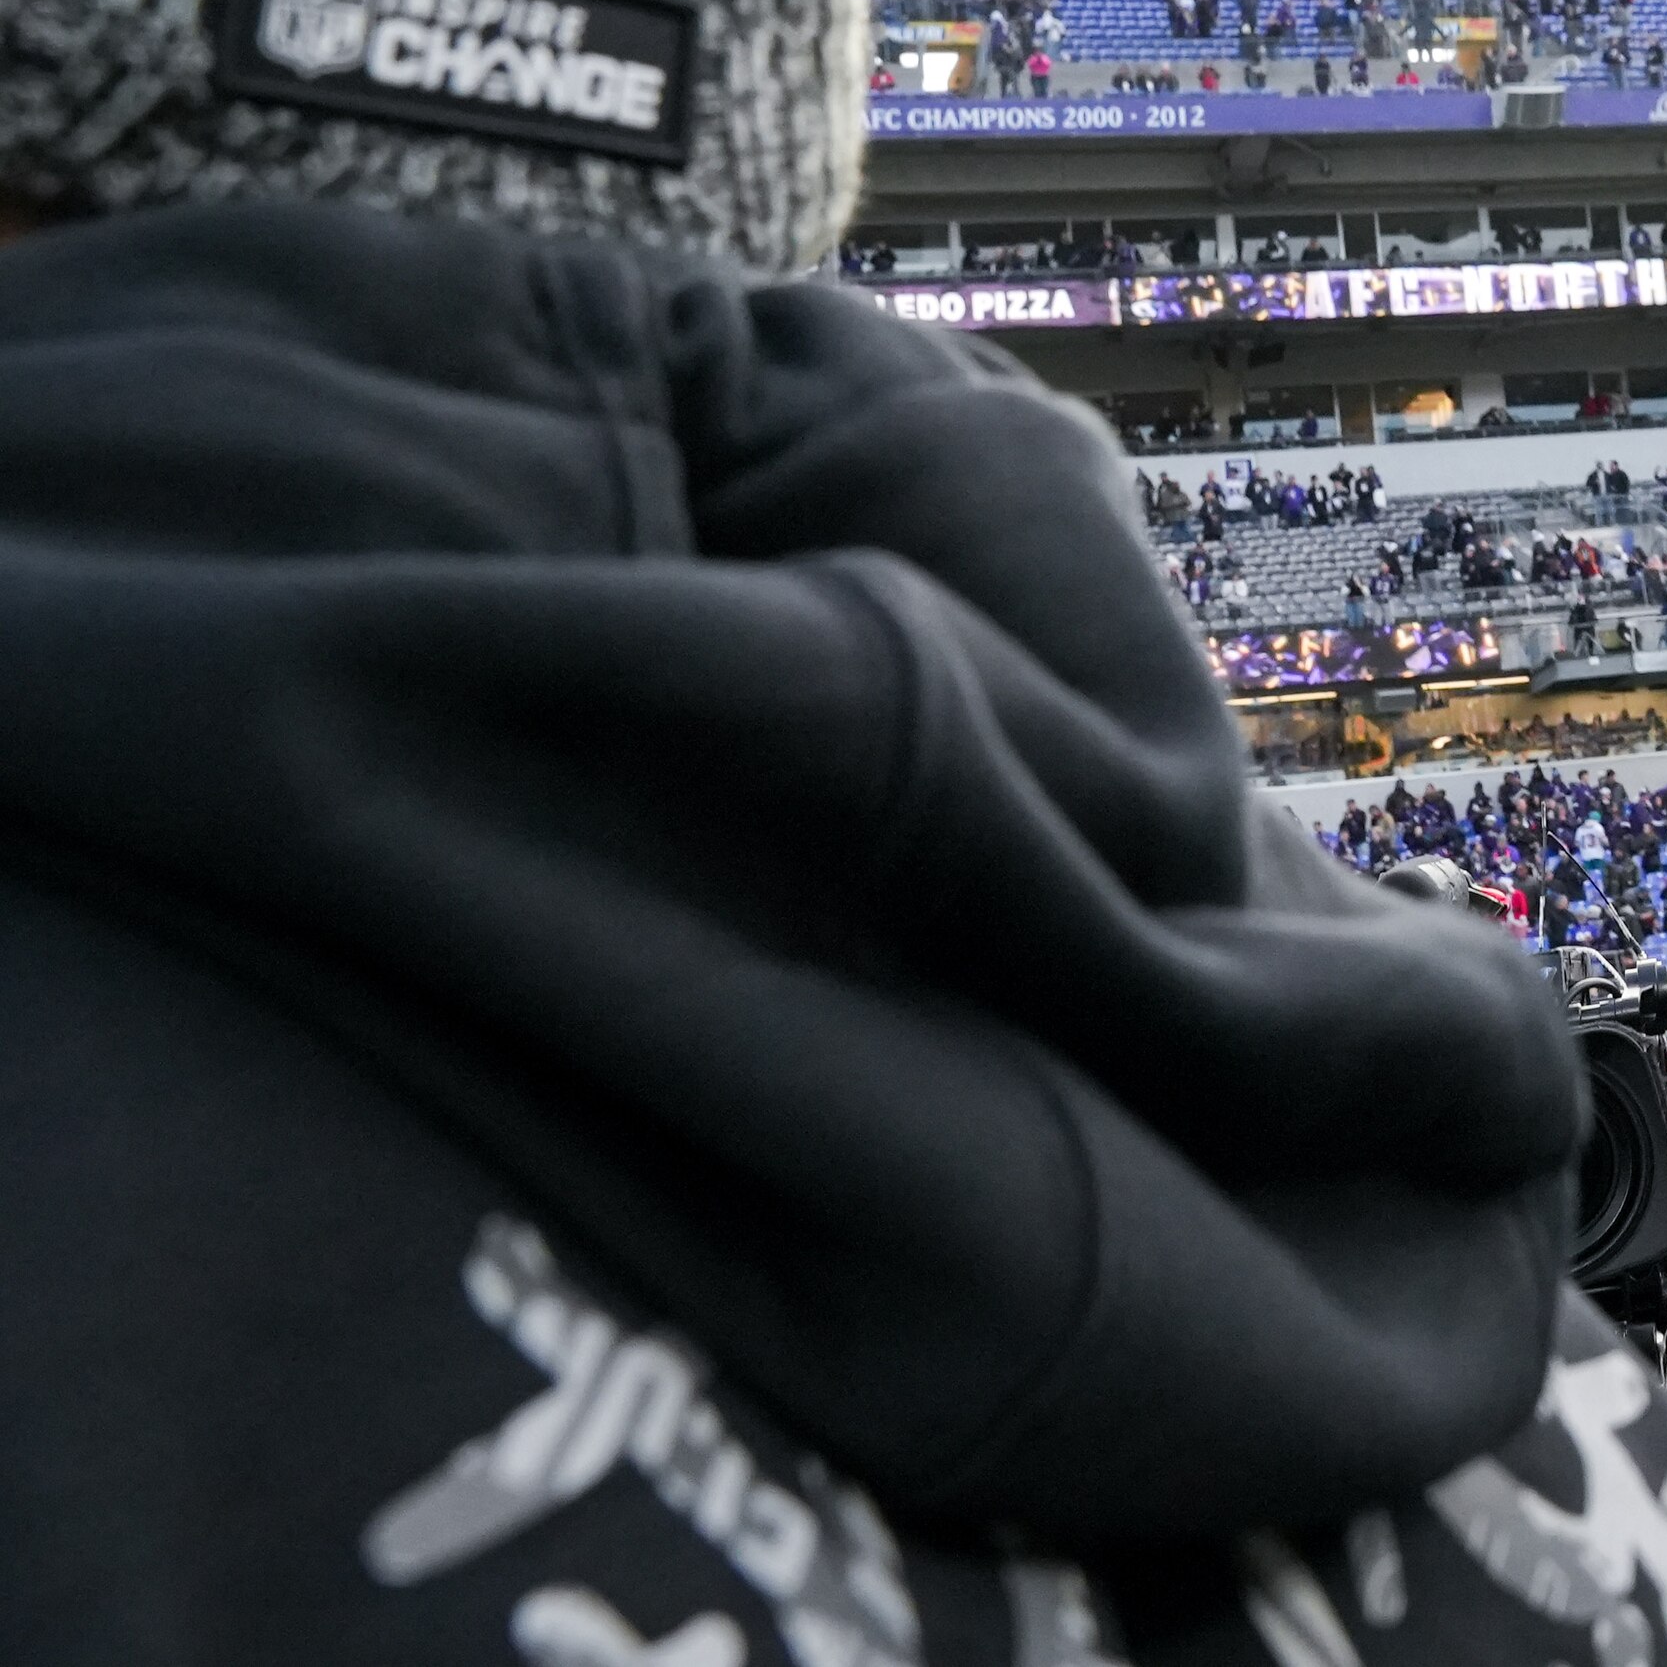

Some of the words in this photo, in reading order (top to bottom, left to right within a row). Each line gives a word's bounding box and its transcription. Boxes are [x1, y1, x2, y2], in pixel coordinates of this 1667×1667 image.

[365, 15, 667, 131] CHANGE
[906, 107, 1057, 132] CHAMPIONS
[1062, 106, 1123, 130] 2000
[1145, 104, 1206, 129] 2012
[971, 288, 1076, 322] PIZZA
[1304, 267, 1421, 320] AFC
